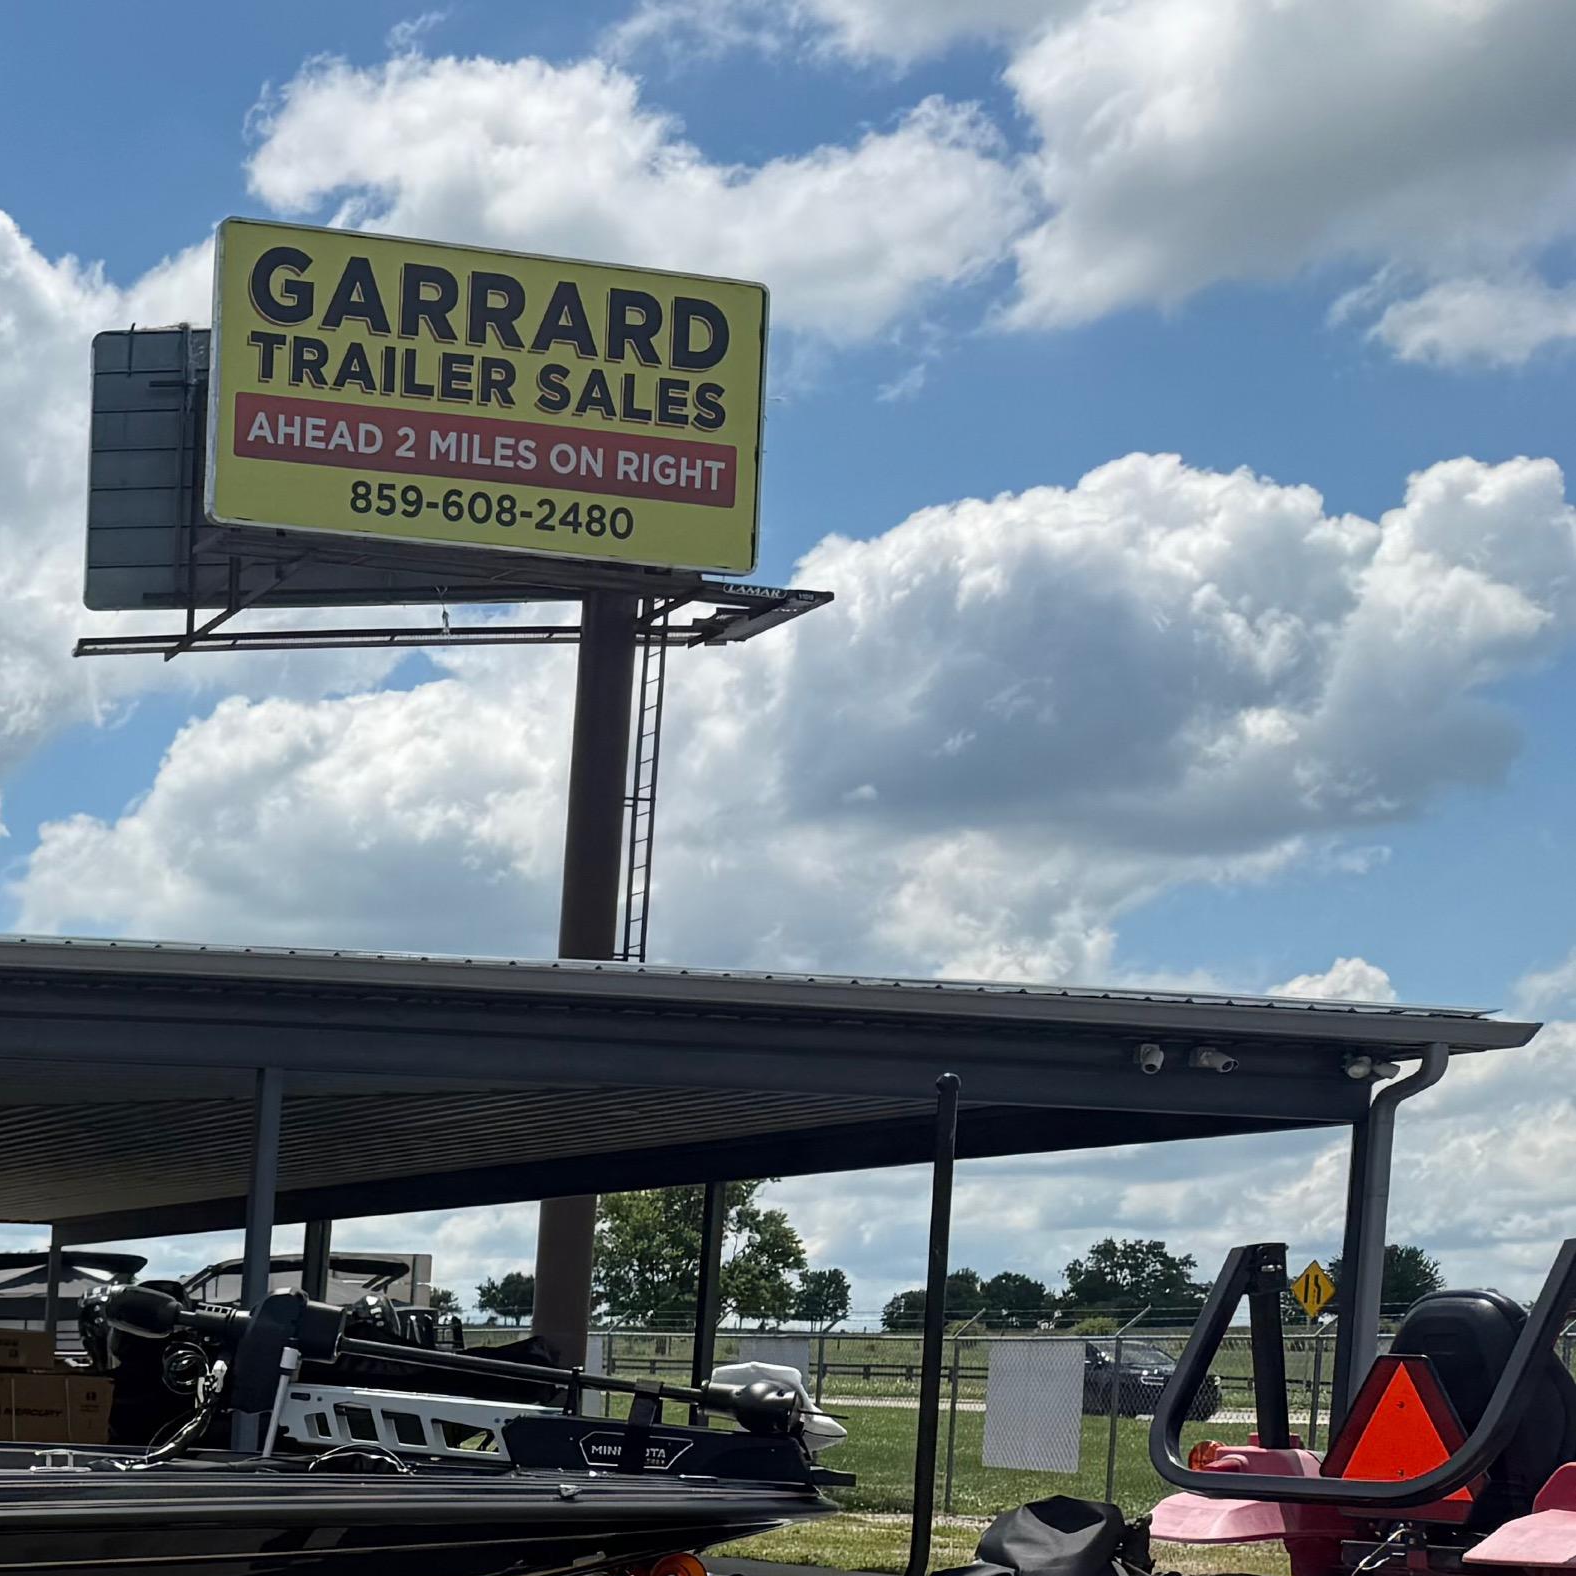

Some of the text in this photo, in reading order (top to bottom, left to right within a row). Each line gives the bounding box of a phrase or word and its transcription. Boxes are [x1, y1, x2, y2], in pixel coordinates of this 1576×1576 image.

[249, 246, 730, 370] GARRARD
[248, 331, 727, 432] TRAILER SALES
[247, 411, 726, 491] AHEAD 2 MILES ON RIGHT
[349, 480, 635, 541] 859-608-2480
[727, 585, 780, 599] LAMAR
